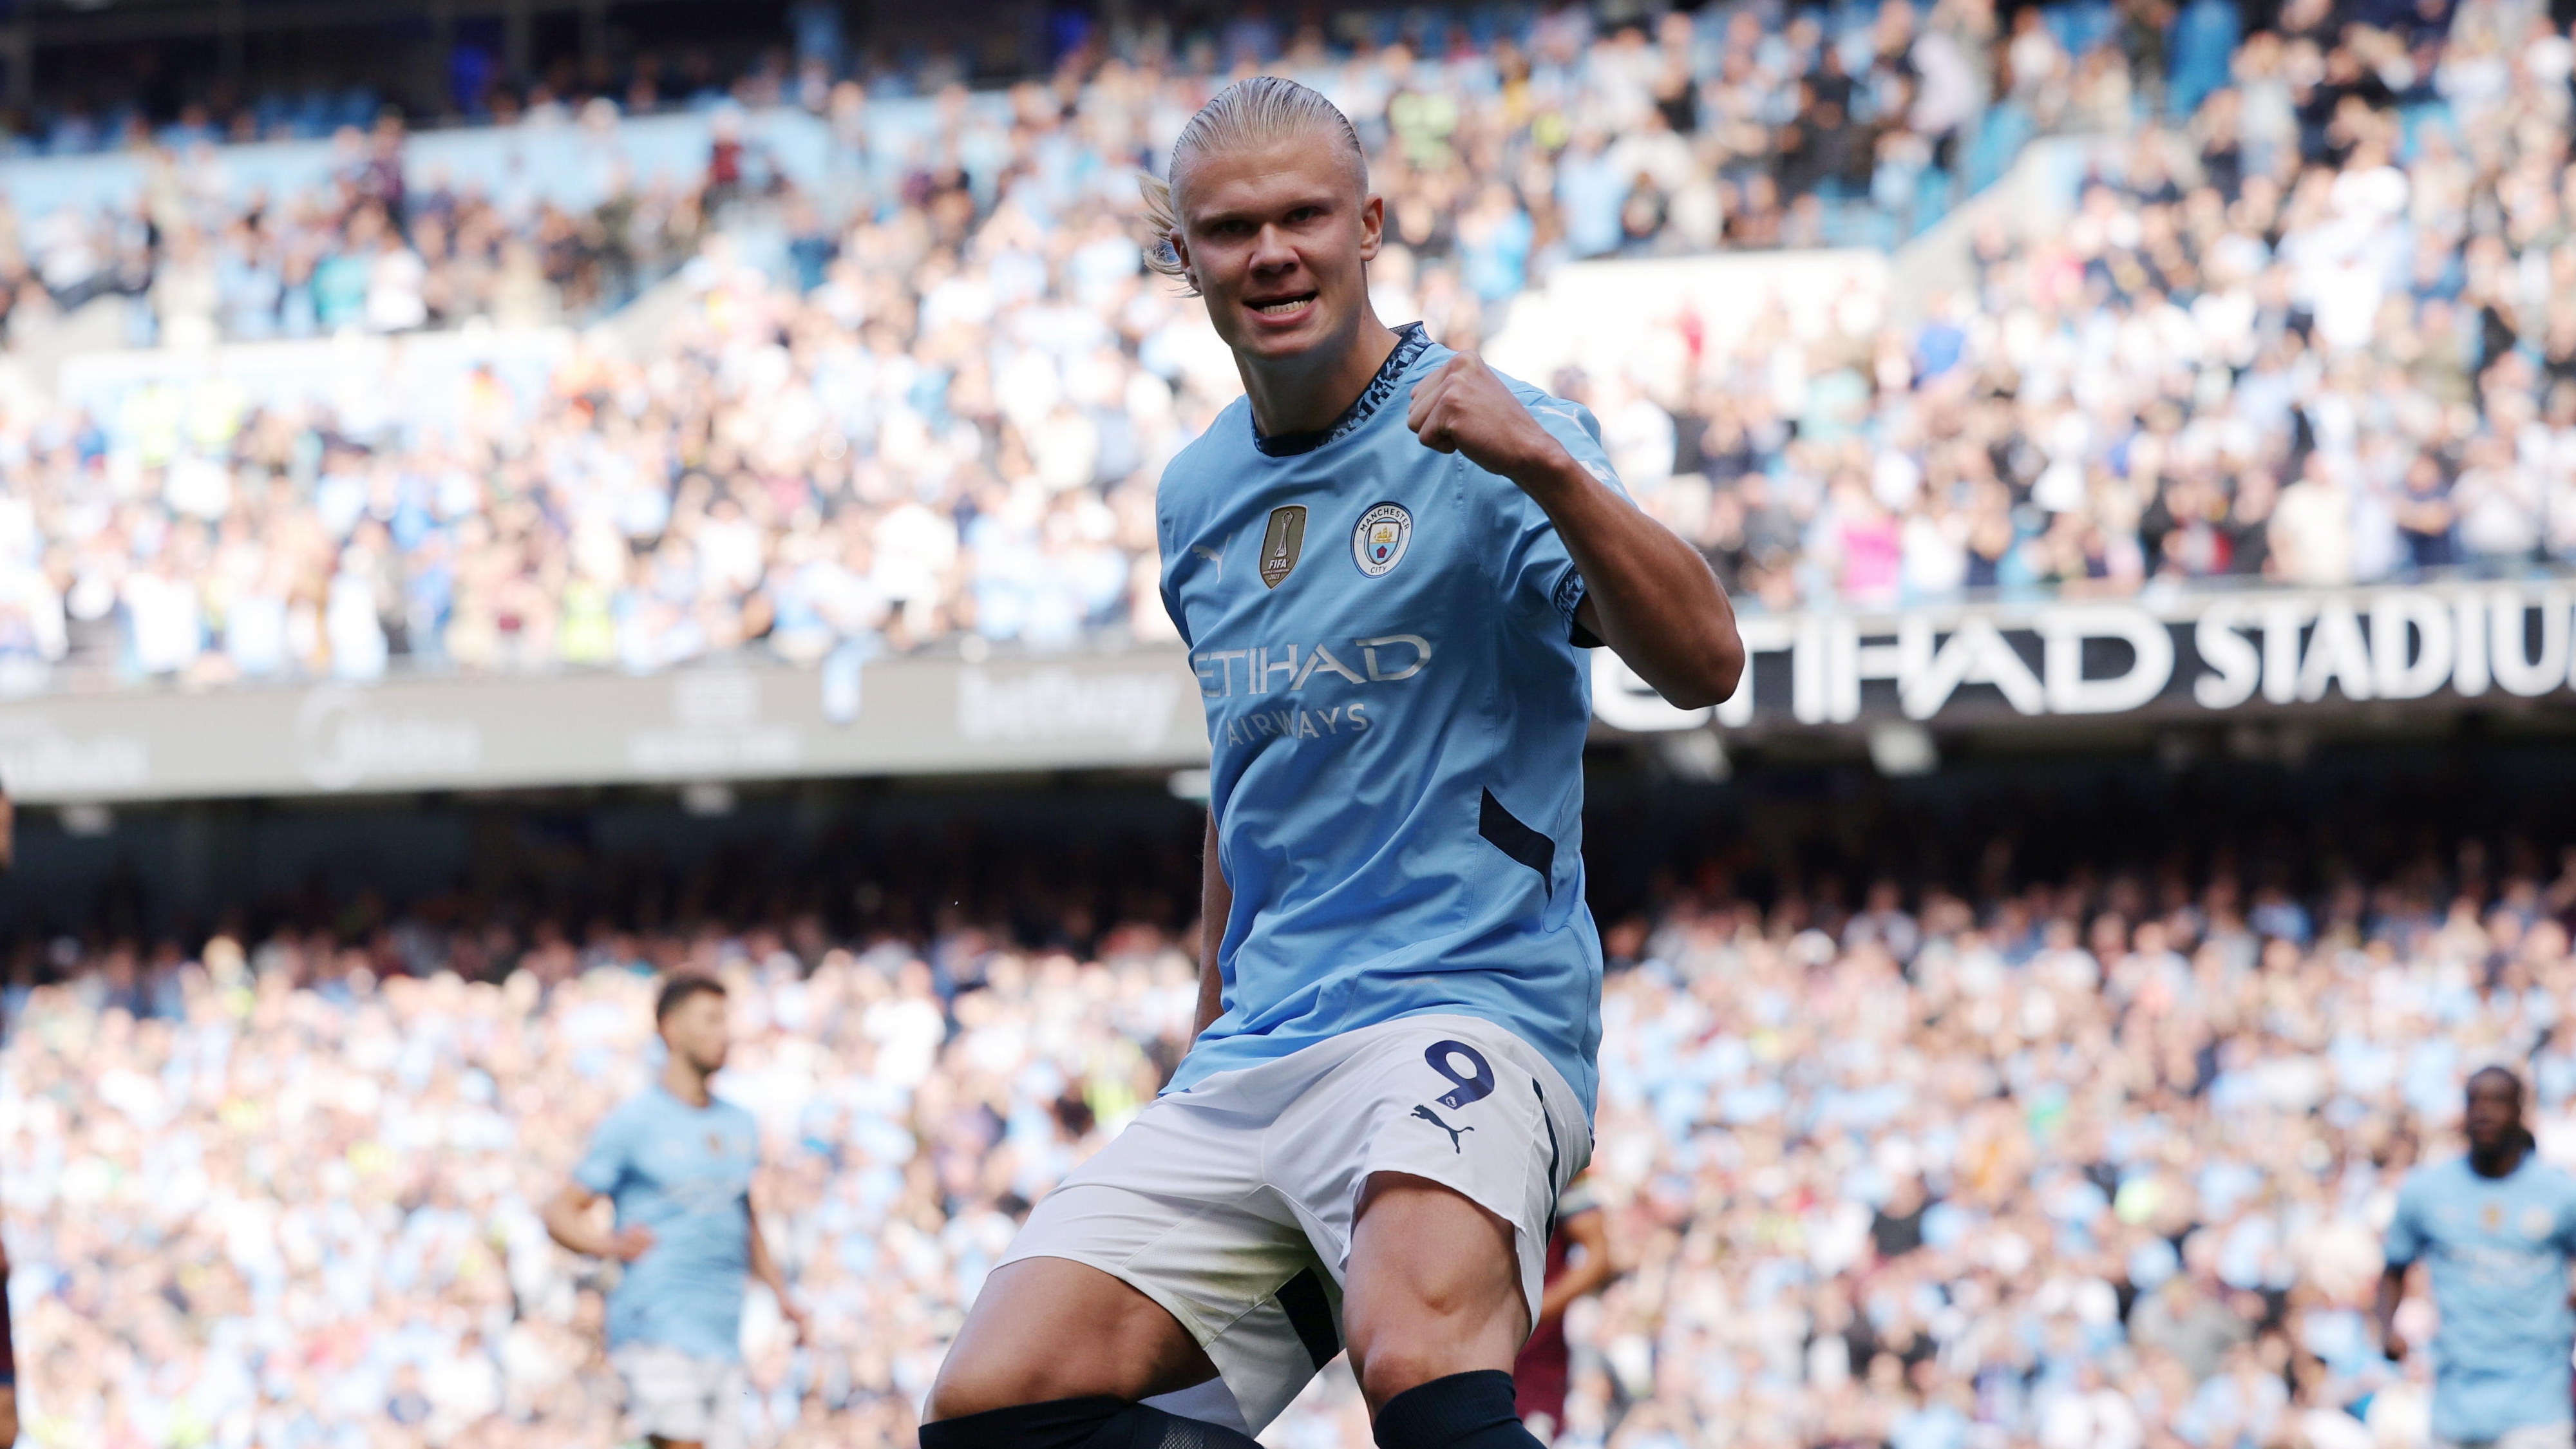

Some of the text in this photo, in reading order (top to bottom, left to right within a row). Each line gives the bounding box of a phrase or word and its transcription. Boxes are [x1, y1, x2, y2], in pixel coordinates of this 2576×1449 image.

[1360, 507, 1410, 532] MANCHESTER
[1269, 558, 1287, 570] FIFA
[1193, 634, 1432, 697] ETIHAD
[2193, 589, 2576, 709] STADIU
[1227, 703, 1369, 747] AIRWAYS
[1425, 1040, 1495, 1110] 9
